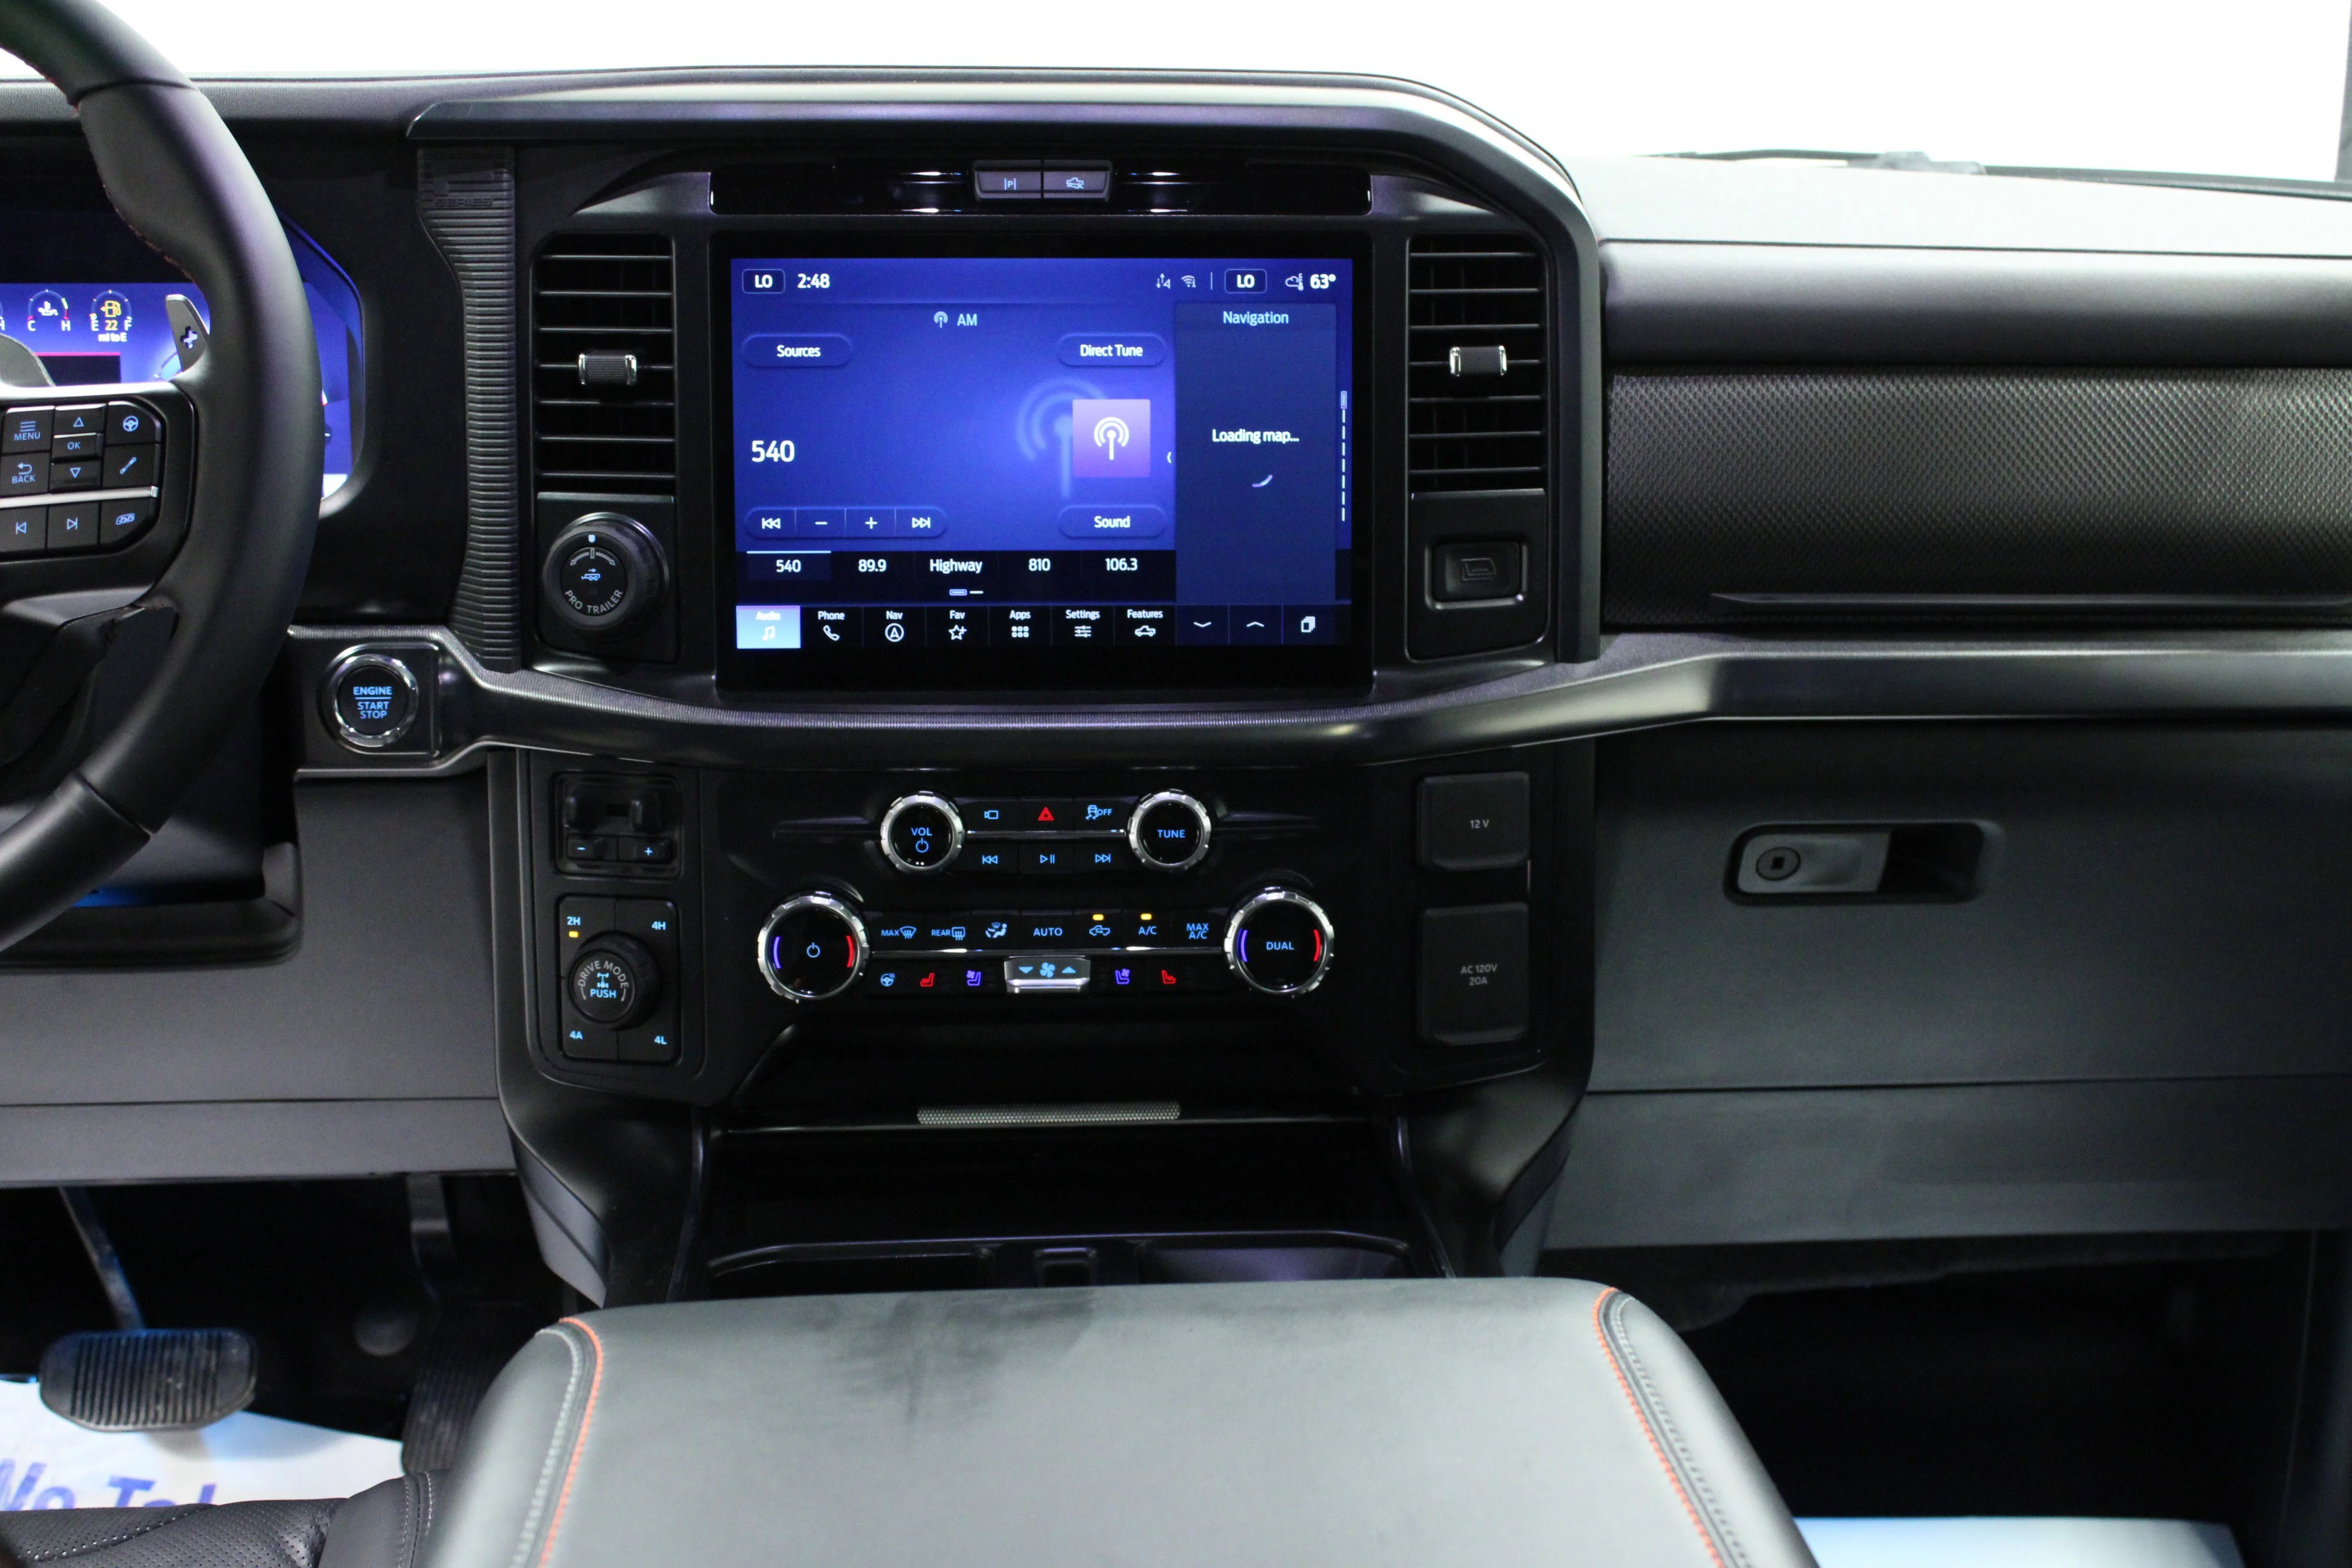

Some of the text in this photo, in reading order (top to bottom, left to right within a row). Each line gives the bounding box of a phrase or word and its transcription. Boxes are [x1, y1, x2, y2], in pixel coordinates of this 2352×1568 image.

[754, 274, 773, 289] LO
[797, 273, 831, 289] 2:48
[1237, 274, 1255, 289] LO
[956, 313, 978, 326] AM
[1223, 311, 1289, 326] Navigation
[27, 319, 37, 332] C
[61, 320, 71, 332] H
[91, 320, 99, 332] E
[104, 319, 118, 331] 22
[124, 320, 132, 331] F
[776, 344, 821, 358] Sources
[1080, 344, 1144, 357] Direct Tune
[14, 432, 41, 441] MENU
[1212, 428, 1300, 445] Loading map...
[67, 442, 80, 450] OK
[752, 440, 795, 463] 540
[12, 474, 35, 484] BACK
[1094, 515, 1131, 528] Sound
[776, 559, 802, 573] 540
[858, 558, 887, 573] 89.9
[929, 558, 983, 574] Highway
[1028, 558, 1051, 571] 810
[1105, 557, 1138, 571] 106.3
[564, 589, 623, 615] PRO TRAILER
[818, 610, 845, 620] Phone
[886, 610, 904, 620] Nav
[949, 609, 966, 620] Fav
[1009, 609, 1031, 620] Apps
[1065, 609, 1100, 620] Settings
[1127, 609, 1164, 619] Features
[353, 686, 393, 696] ENGINE
[357, 701, 390, 710] START
[360, 710, 387, 719] STOP
[1097, 808, 1113, 816] OFF
[1470, 819, 1489, 829] 12 V
[911, 827, 933, 837] VOL
[1157, 829, 1185, 838] TUNE
[567, 916, 581, 926] 2H
[651, 921, 667, 930] 4H
[1033, 927, 1063, 936] AUTO
[1138, 925, 1157, 936] A/C
[1186, 923, 1209, 931] MAX
[1188, 931, 1207, 939] A/C
[1266, 941, 1295, 950] DUAL
[577, 960, 630, 989] DRIVE MODE
[1461, 963, 1498, 975] AC 120V
[1469, 976, 1488, 986] 20A
[590, 989, 617, 999] PUSH
[569, 1030, 583, 1040] 4A
[654, 1035, 667, 1045] 4L
